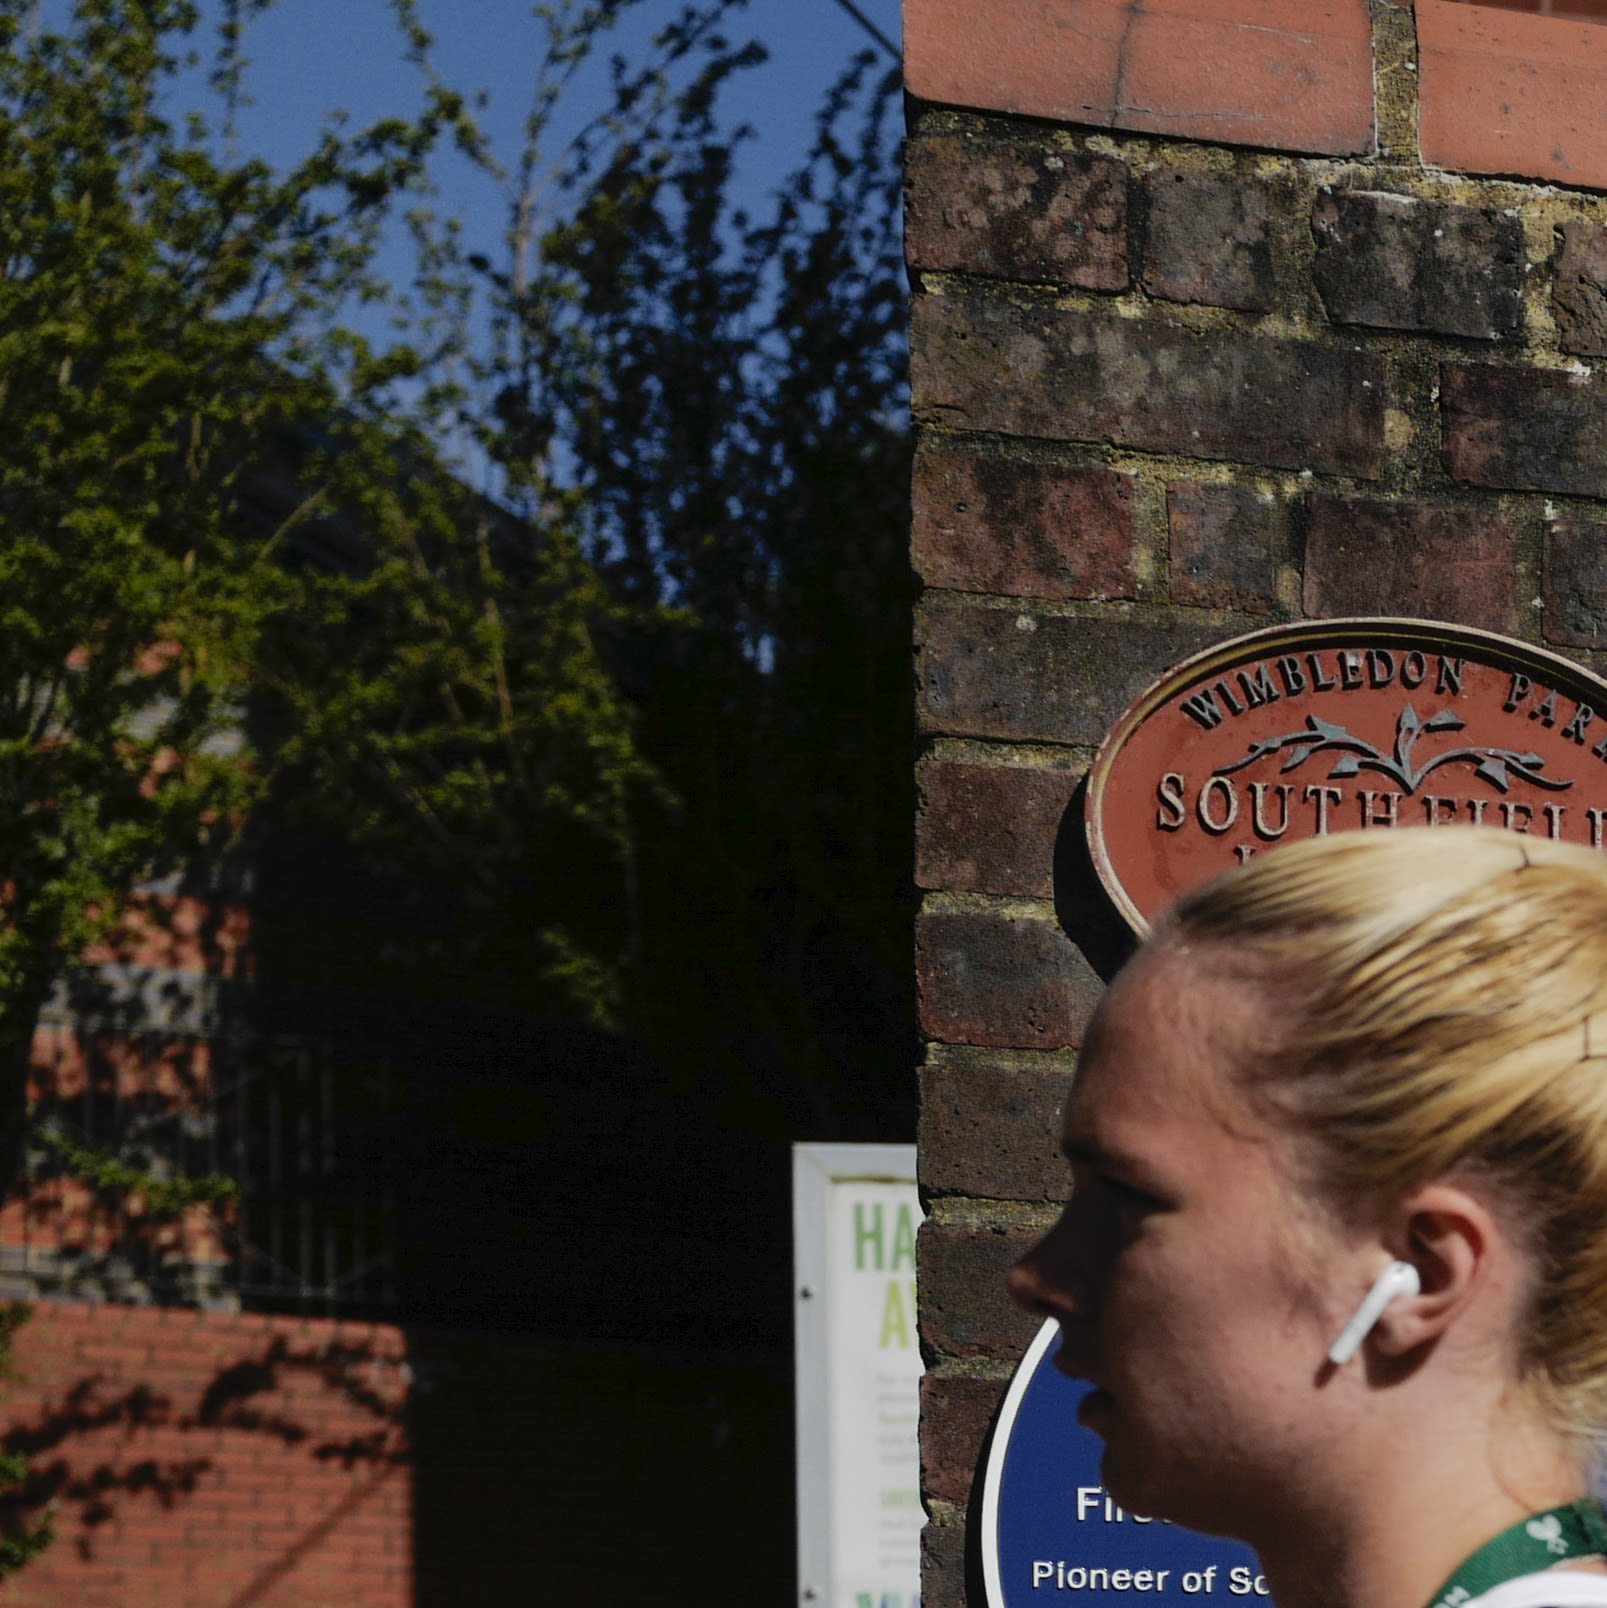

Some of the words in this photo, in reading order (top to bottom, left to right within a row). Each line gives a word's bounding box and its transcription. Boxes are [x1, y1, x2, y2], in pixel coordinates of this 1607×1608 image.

[1179, 649, 1465, 730] WIMBLEDON
[1032, 1560, 1171, 1592] Pioneer
[1182, 1564, 1218, 1593] of
